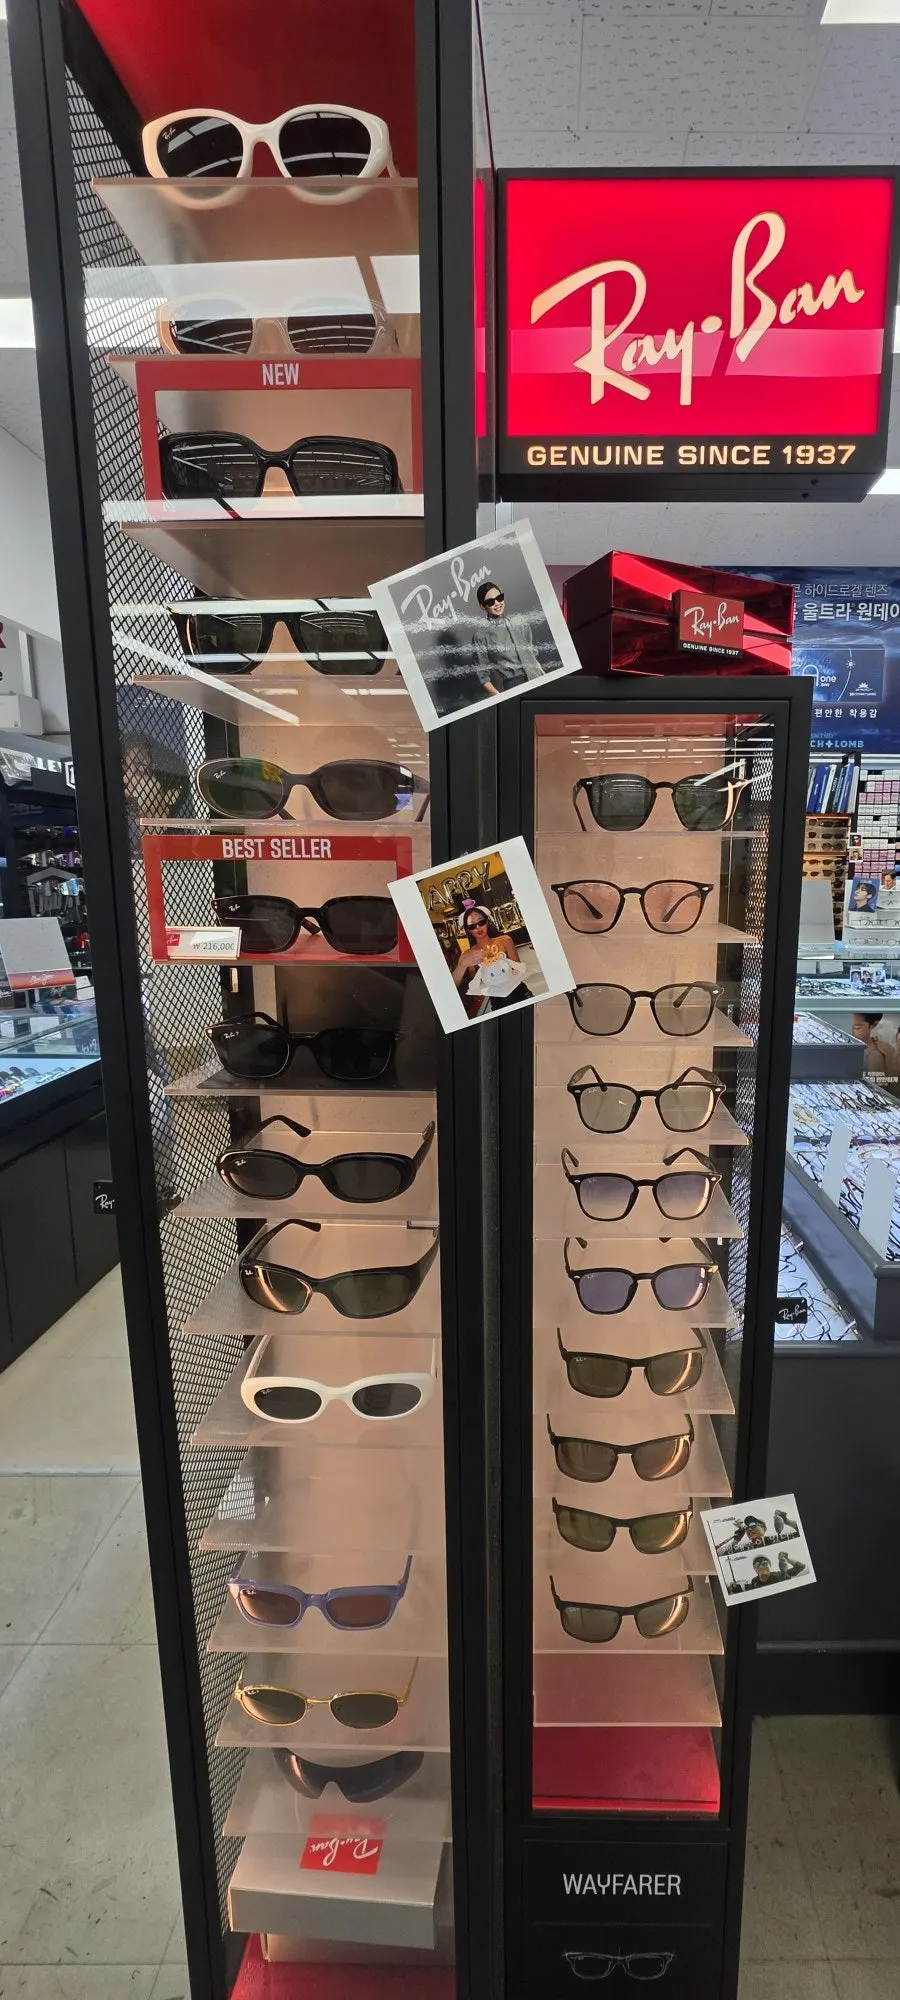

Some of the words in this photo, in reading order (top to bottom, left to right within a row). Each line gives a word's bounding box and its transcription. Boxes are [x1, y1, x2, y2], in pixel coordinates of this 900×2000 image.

[261, 363, 299, 386] NEW
[527, 444, 664, 466] GENUINE
[677, 444, 771, 466] SINCE
[781, 444, 857, 465] 1937
[804, 583, 862, 598] 하이드로겔
[865, 583, 888, 598] 렌즈
[802, 602, 852, 622] 울트라
[682, 642, 708, 652] GENUINE
[708, 646, 725, 654] SINCE
[222, 838, 265, 859] BEST
[270, 838, 332, 859] SELLER
[562, 1872, 682, 1896] WAYFARER
